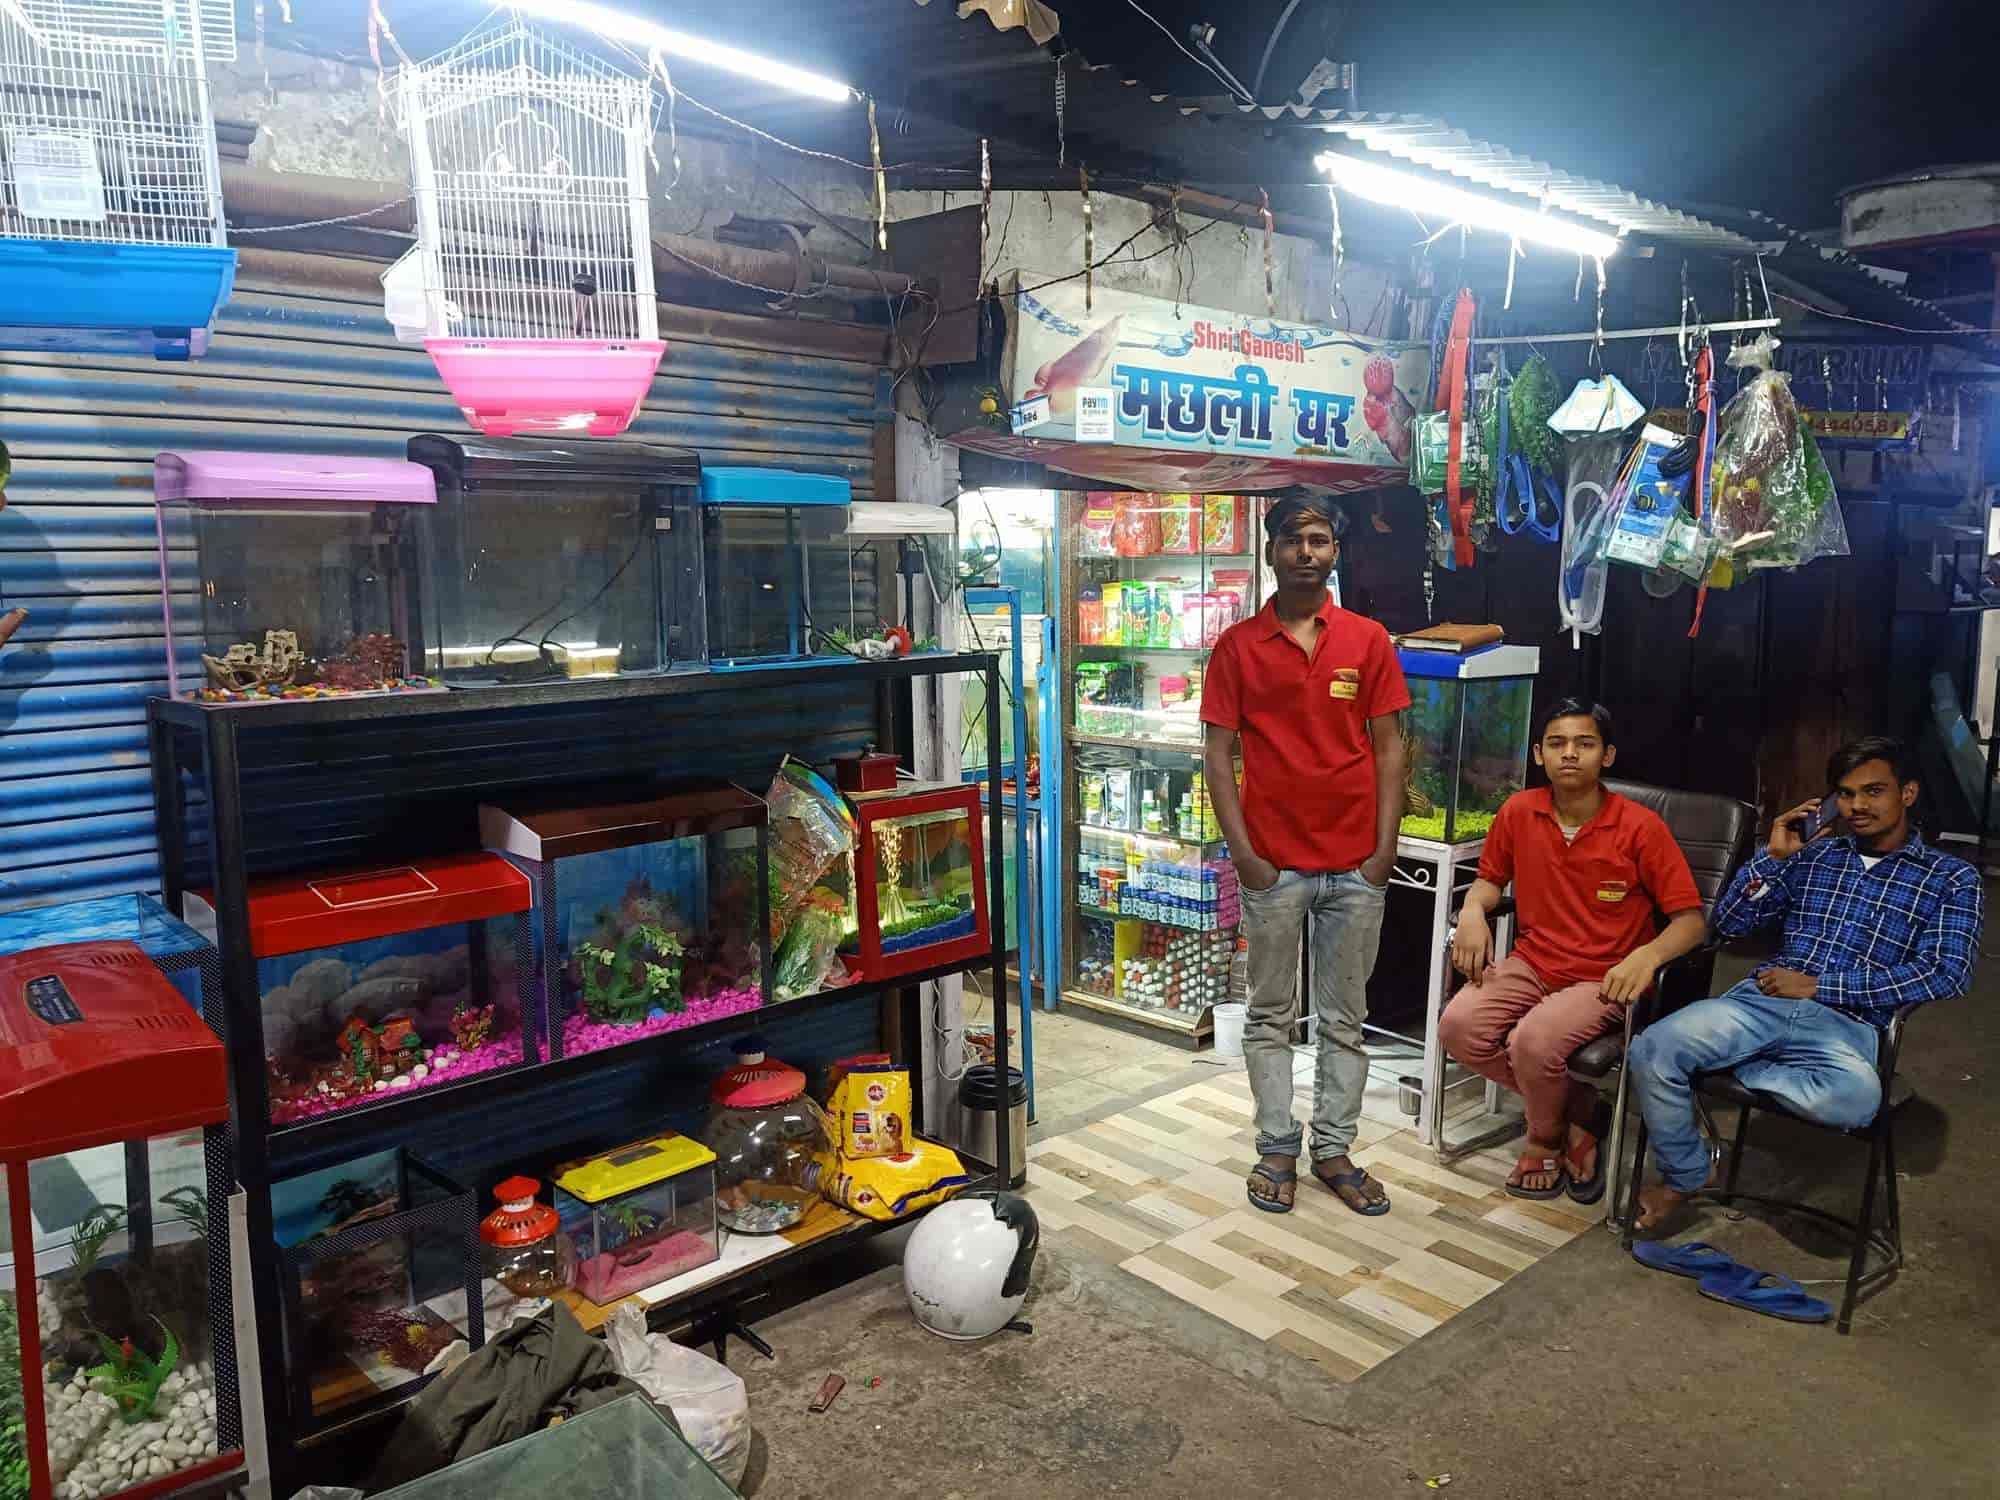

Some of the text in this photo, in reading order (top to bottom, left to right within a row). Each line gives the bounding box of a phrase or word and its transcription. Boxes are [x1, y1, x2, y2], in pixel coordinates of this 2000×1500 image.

[1193, 320, 1305, 364] Shri Ganesh
[1113, 363, 1356, 450] मछली घर
